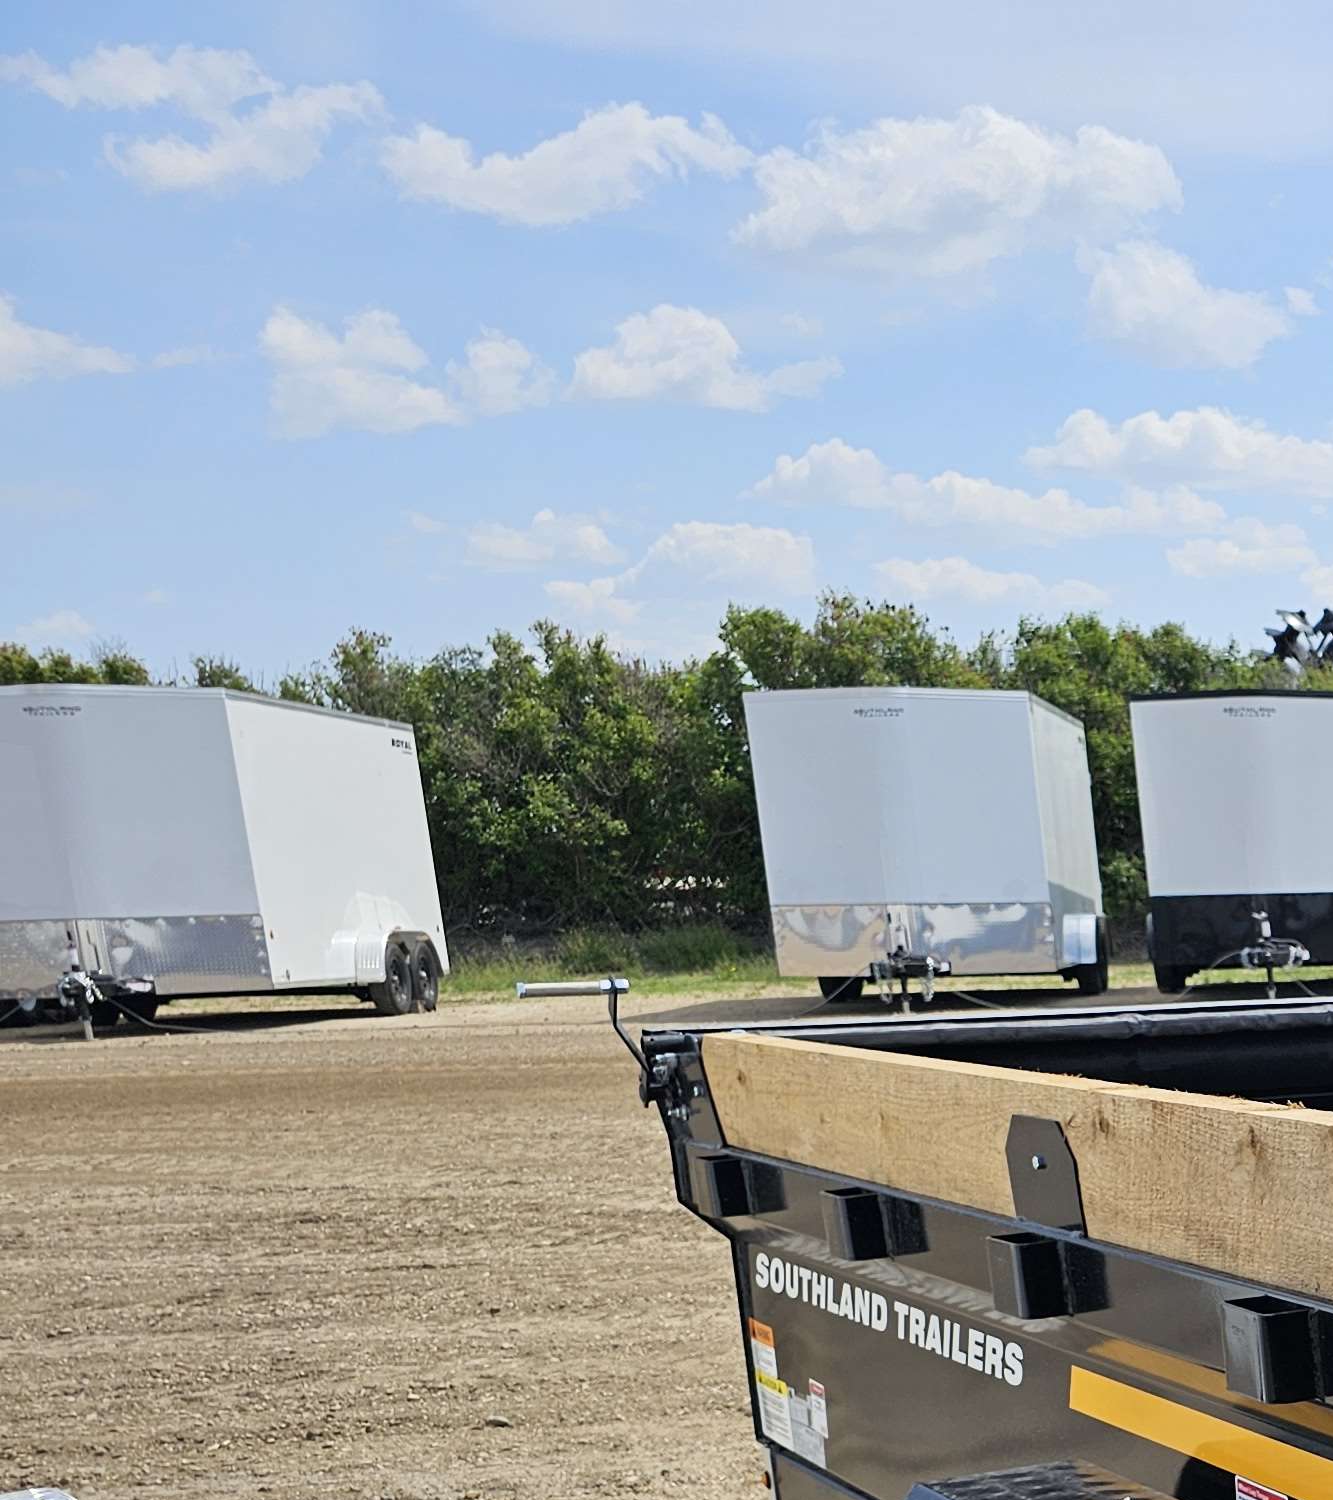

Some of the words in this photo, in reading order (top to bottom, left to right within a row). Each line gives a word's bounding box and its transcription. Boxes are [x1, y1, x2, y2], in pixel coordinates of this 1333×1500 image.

[391, 738, 412, 750] ROYAL
[755, 1252, 888, 1332] SOUTHLAND
[894, 1300, 1024, 1387] TRAILERS
